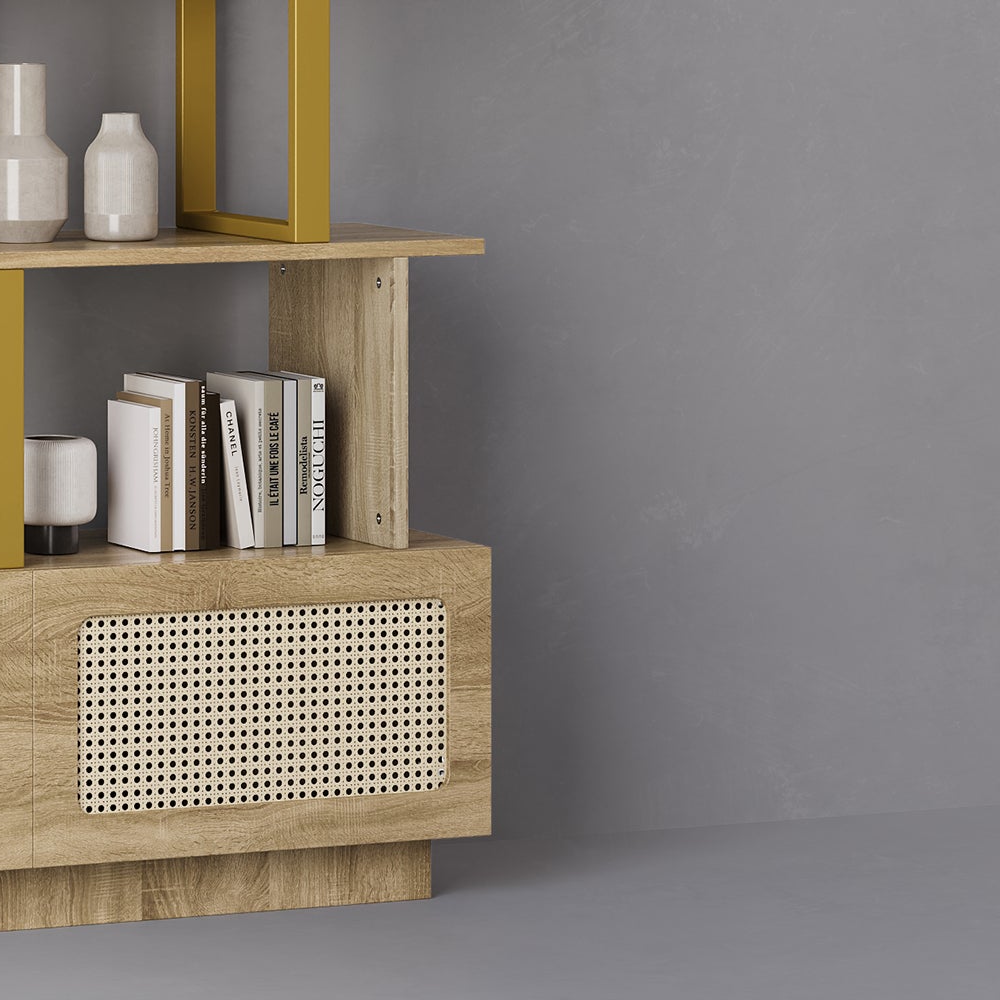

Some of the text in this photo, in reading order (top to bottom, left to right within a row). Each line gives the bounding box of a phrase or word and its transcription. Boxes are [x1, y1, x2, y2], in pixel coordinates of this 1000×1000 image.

[164, 414, 170, 423] At
[268, 412, 279, 431] CAFÉ
[226, 411, 237, 457] CHANEL
[270, 432, 279, 442] LE
[164, 446, 170, 454] in
[270, 443, 279, 458] FOIS
[270, 461, 279, 476] UNE
[300, 436, 308, 494] Remodelista
[313, 420, 324, 511] NOGUCHI
[268, 478, 279, 498] ÉTAIT
